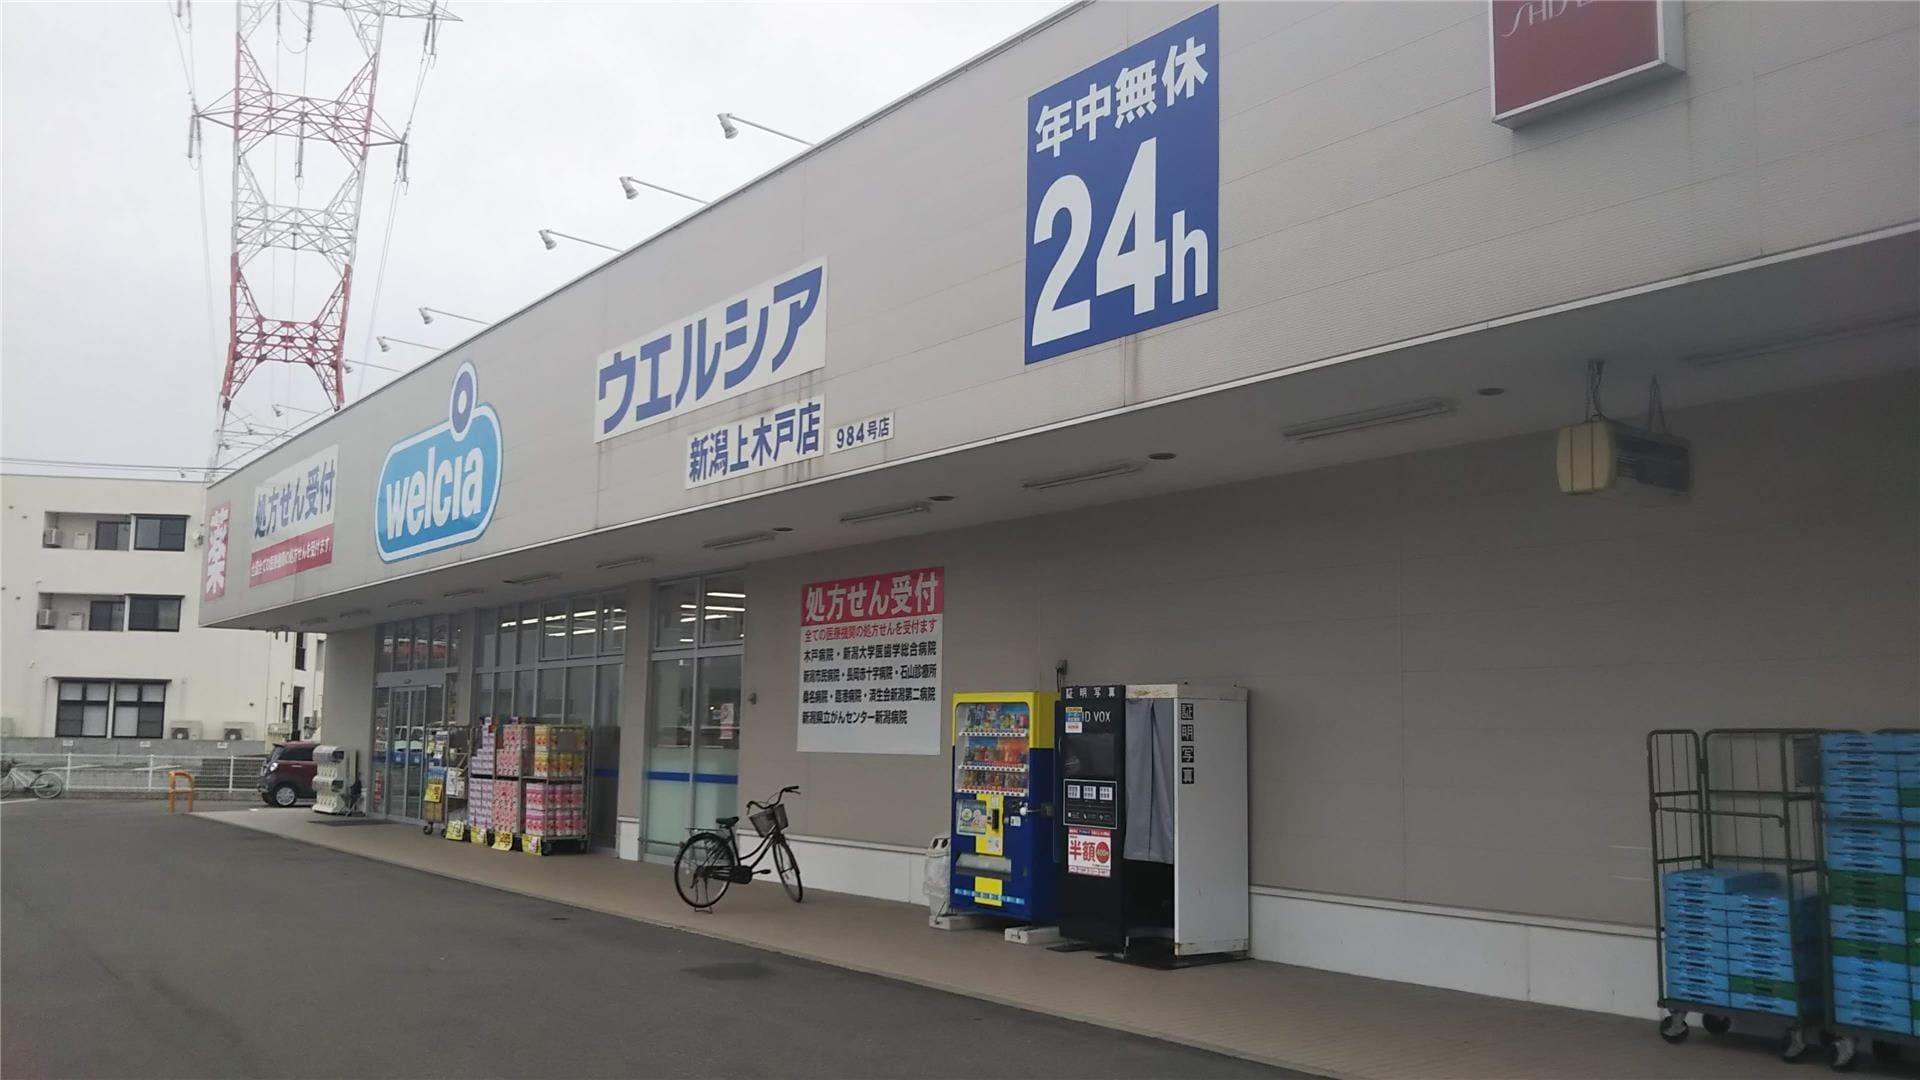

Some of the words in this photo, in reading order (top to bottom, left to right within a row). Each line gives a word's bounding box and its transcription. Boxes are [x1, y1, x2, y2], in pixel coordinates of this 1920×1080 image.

[1034, 36, 1209, 158] 年中無休
[1031, 136, 1209, 347] 24h
[599, 266, 823, 435] ウエルシア
[384, 371, 484, 541] welcia
[689, 401, 822, 483] 新潟上木戸店
[836, 416, 890, 449] 984号店
[253, 459, 336, 540] 処方せん受付
[206, 507, 229, 595] 薬
[805, 571, 939, 623] 処方せん受付
[1065, 687, 1115, 699] 証明写真
[1093, 711, 1111, 722] VOX
[1181, 703, 1195, 785] 証明写真
[1069, 839, 1096, 862] 半額
